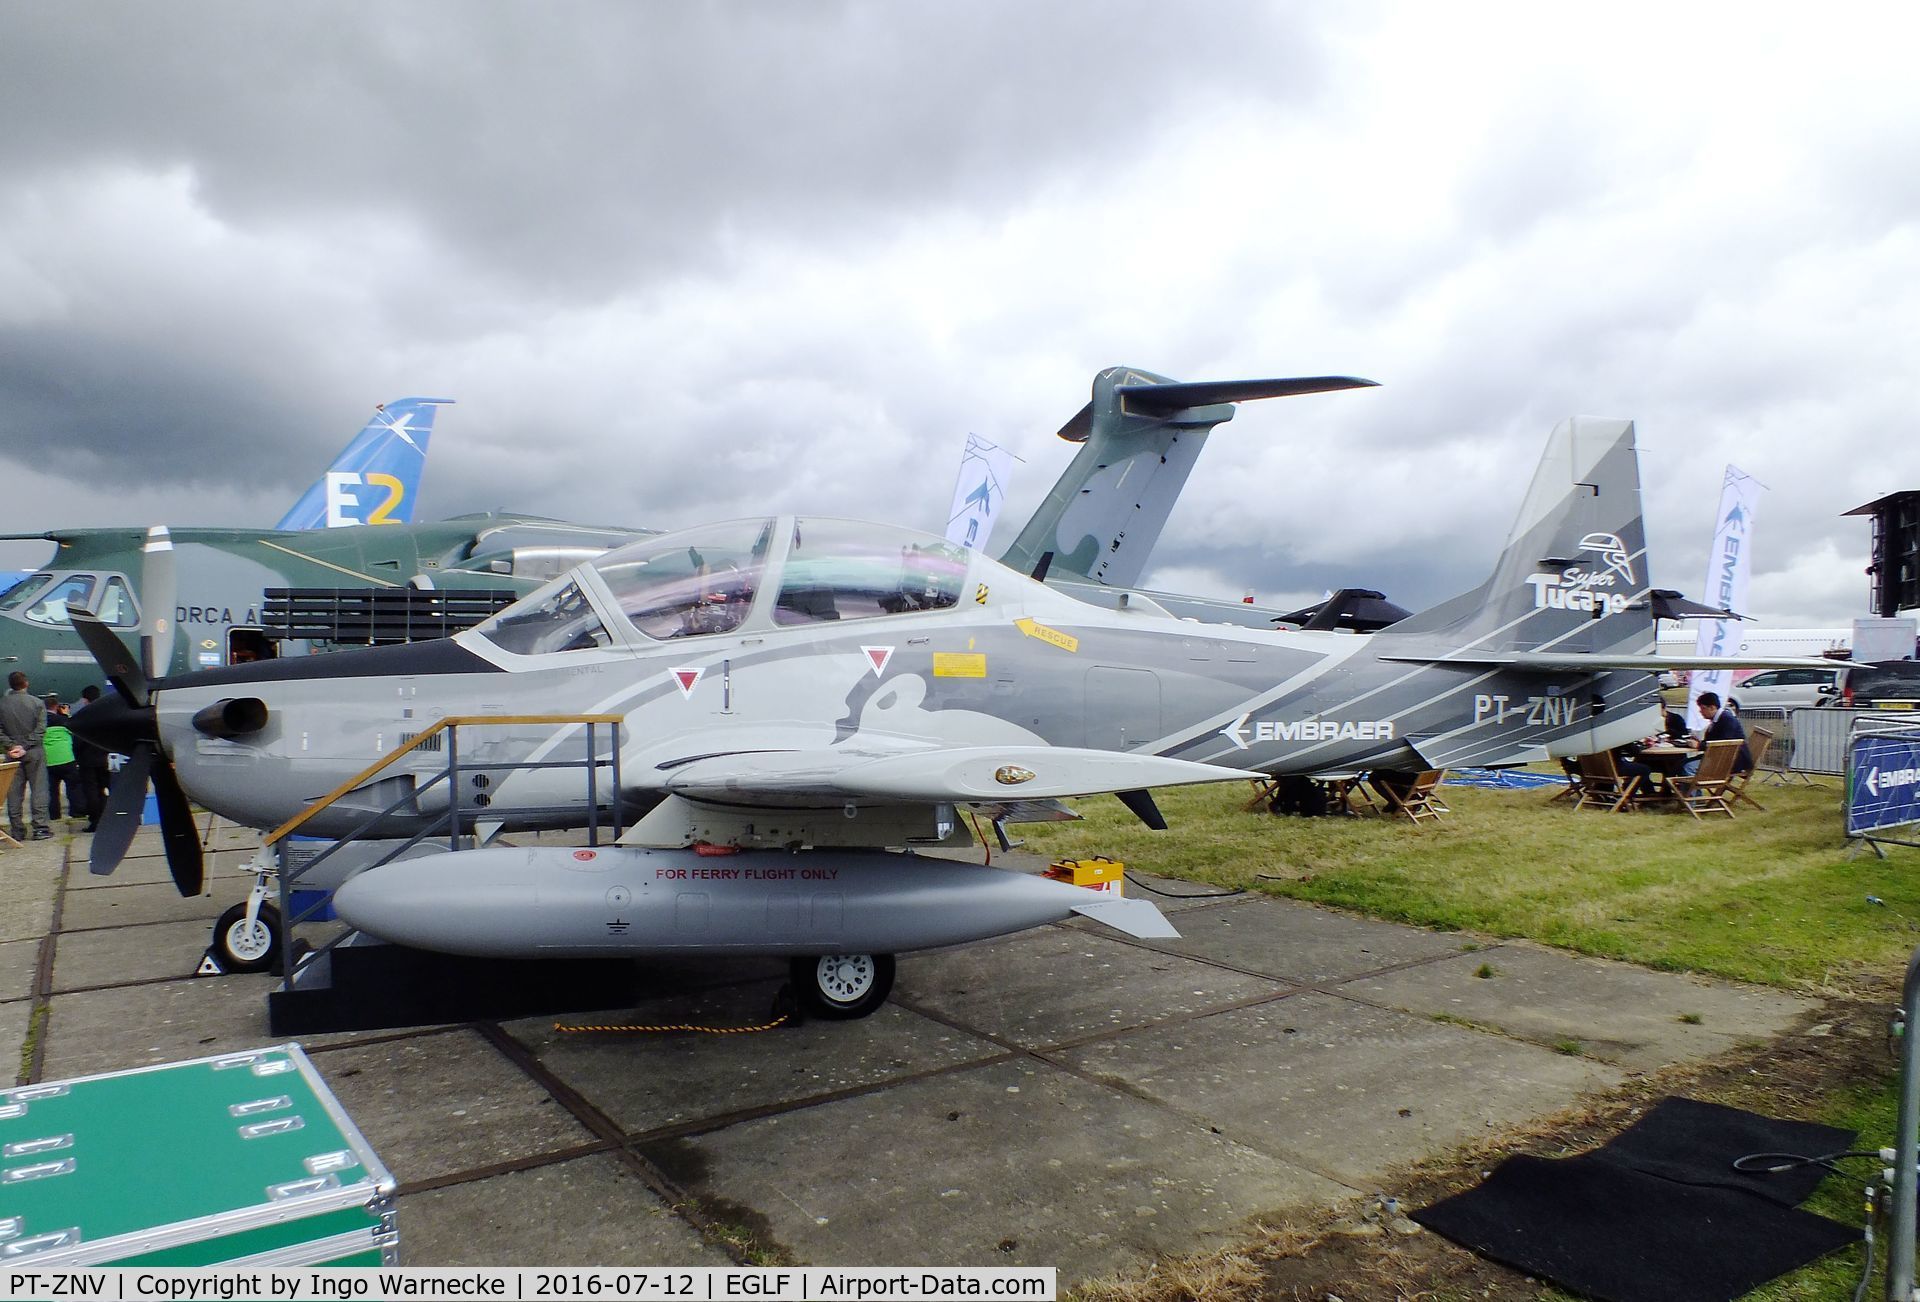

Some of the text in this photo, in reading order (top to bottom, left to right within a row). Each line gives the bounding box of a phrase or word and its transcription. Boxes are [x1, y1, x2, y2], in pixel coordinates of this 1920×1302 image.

[327, 472, 404, 528] E2
[1560, 567, 1616, 590] Super
[1525, 573, 1627, 615] Tucano
[1034, 626, 1074, 648] RESCUE
[1475, 694, 1576, 726] PT-ZNV
[1256, 721, 1394, 741] EMBRAER
[656, 868, 838, 880] FOR FERRY FLIGHT ONLY
